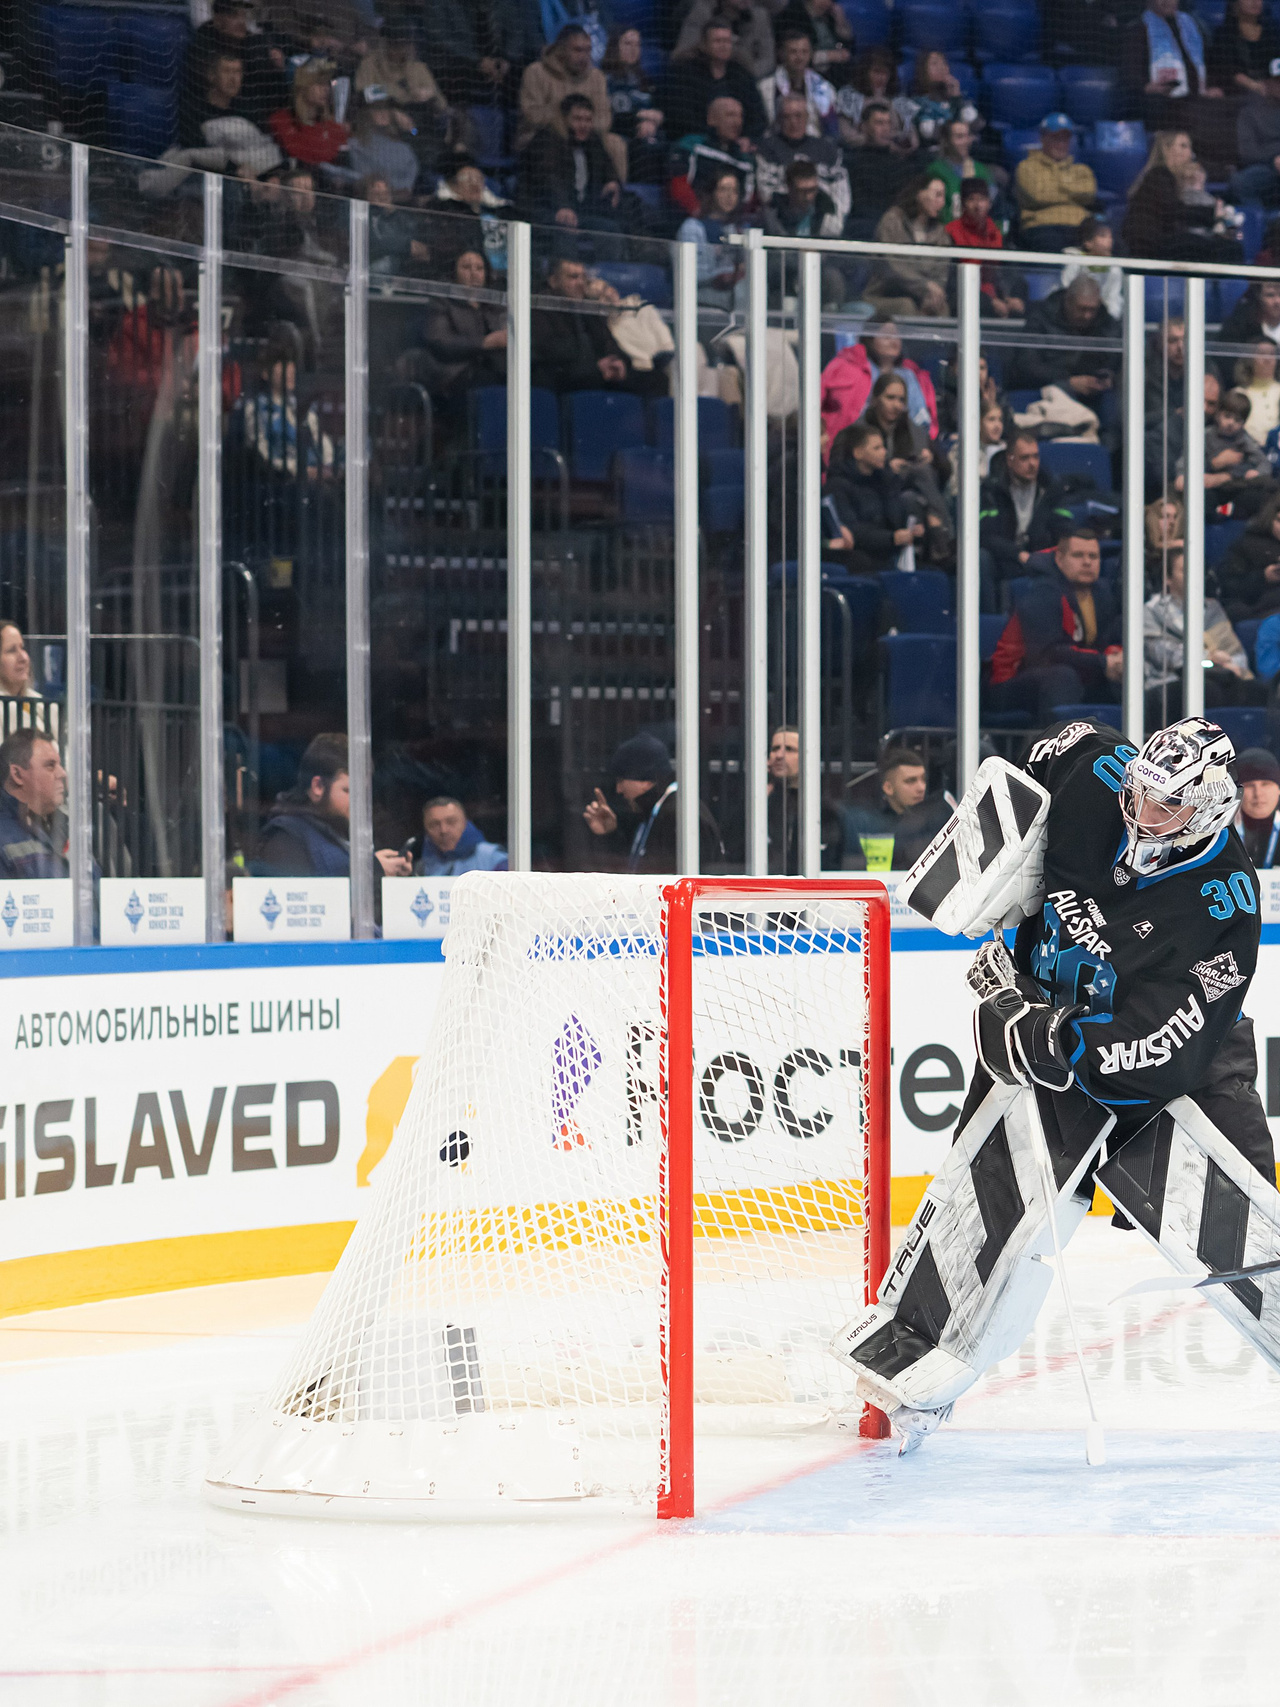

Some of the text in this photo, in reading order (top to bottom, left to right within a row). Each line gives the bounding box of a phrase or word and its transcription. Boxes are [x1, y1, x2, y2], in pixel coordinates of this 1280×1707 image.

[905, 816, 960, 883] TRUE
[1200, 871, 1258, 920] 30
[15, 998, 340, 1050] АВТОМОБИЛЬНЫЕ ШИНЫ
[883, 1199, 937, 1298] TRUE
